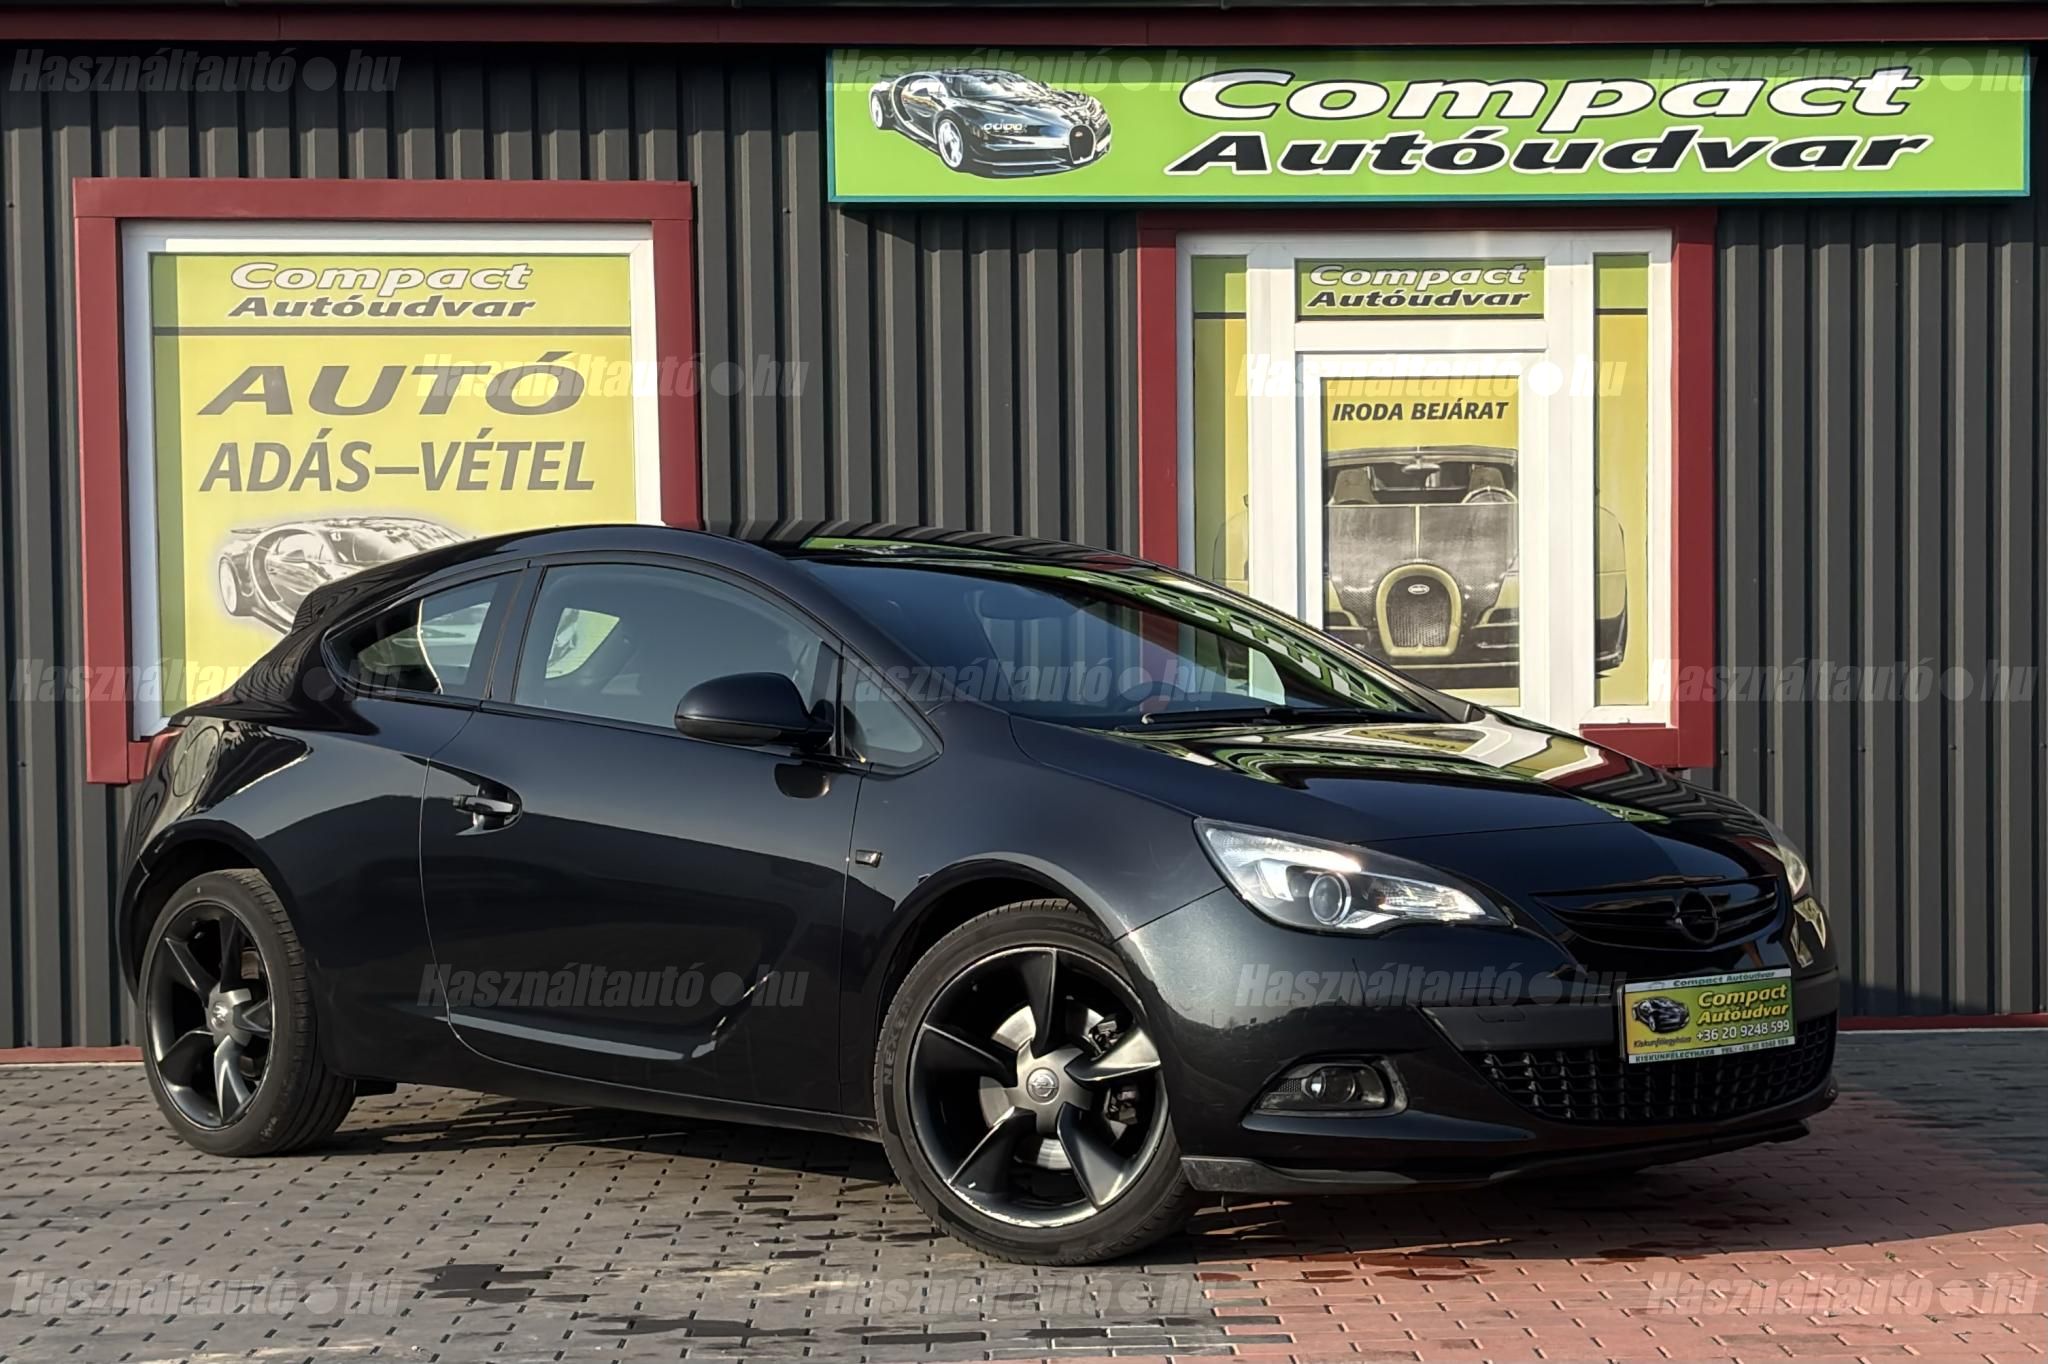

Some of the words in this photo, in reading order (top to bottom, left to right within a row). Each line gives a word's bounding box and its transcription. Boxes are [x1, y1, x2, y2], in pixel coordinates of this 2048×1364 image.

[1179, 66, 1924, 134] Compact
[1162, 125, 1934, 176] Autóudvar
[229, 261, 534, 298] Compact
[1308, 263, 1529, 291] Compact
[227, 293, 536, 319] Autóudvar
[1306, 287, 1531, 309] Autóudvar
[197, 351, 586, 416] AUTÓ
[1332, 402, 1404, 422] IRODA
[1411, 397, 1509, 421] BEJÁRAT
[1697, 984, 1787, 1008] Compact
[1696, 1004, 1790, 1025] Autóudvar
[1696, 1028, 1719, 1042] +36
[1721, 1026, 1737, 1039] 20
[1740, 1022, 1768, 1037] 9248
[1770, 1019, 1790, 1033] 599
